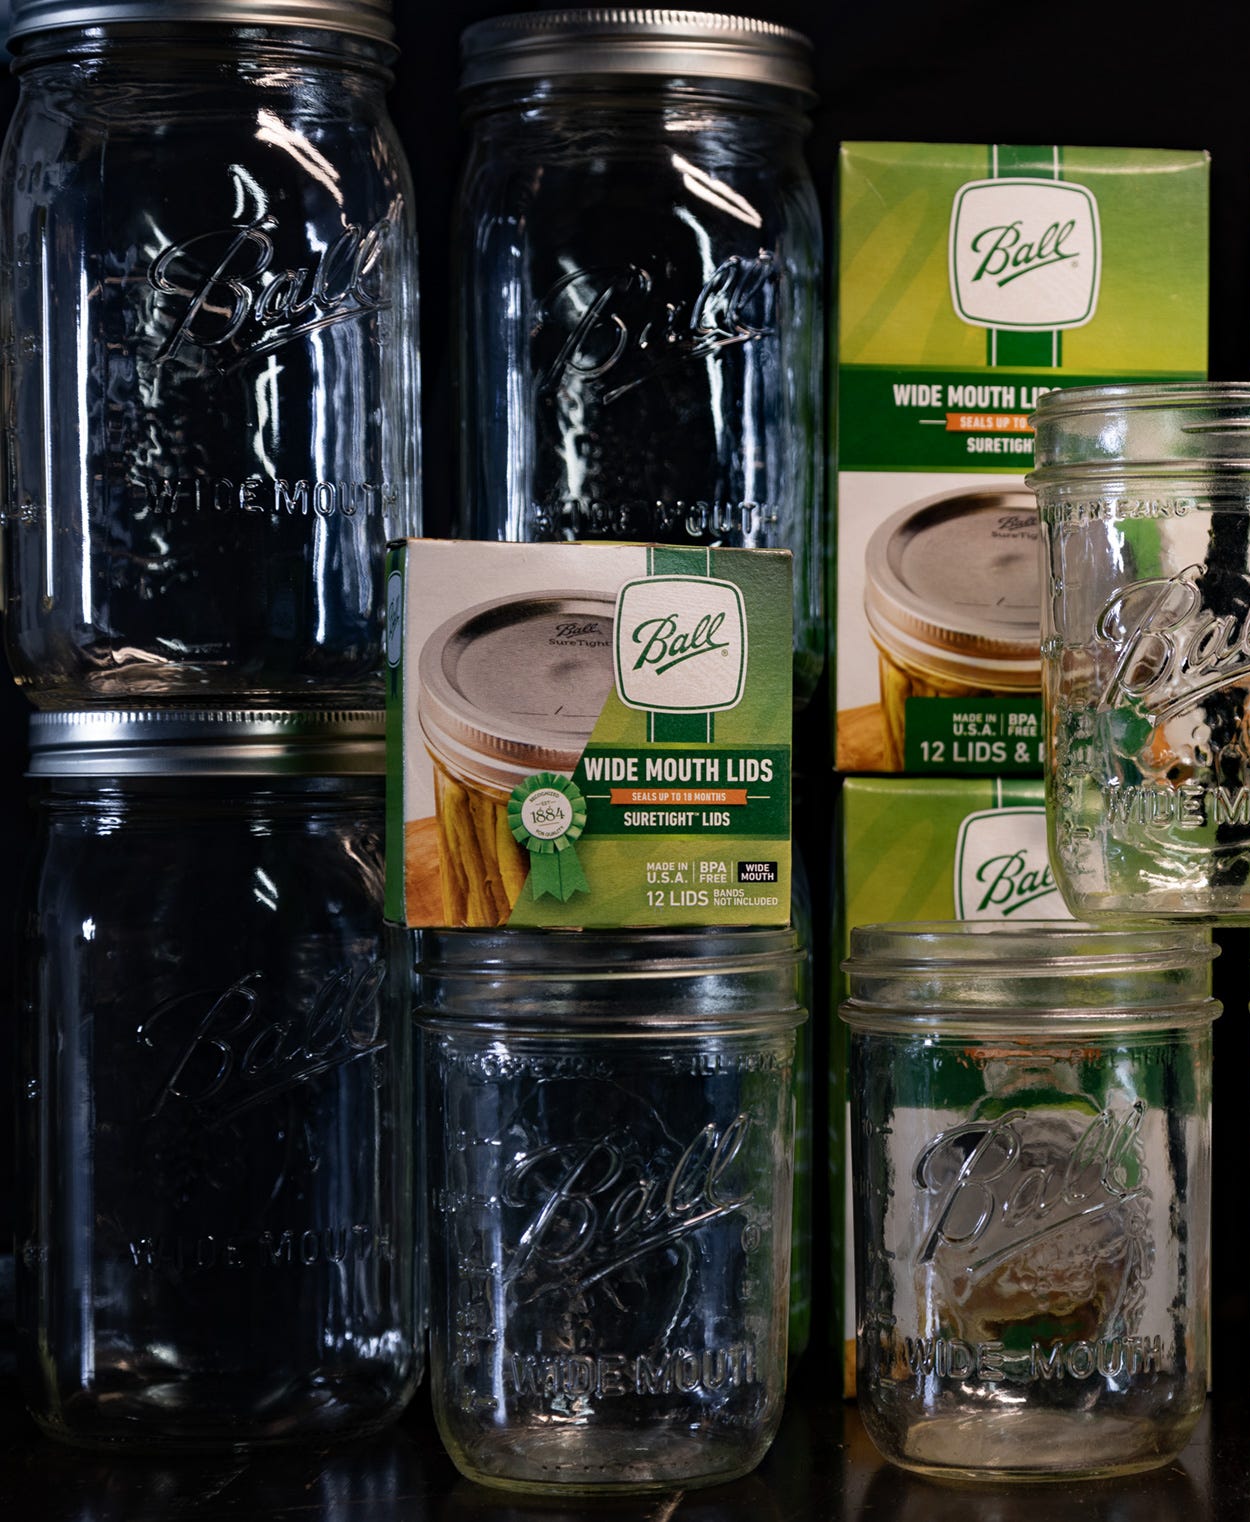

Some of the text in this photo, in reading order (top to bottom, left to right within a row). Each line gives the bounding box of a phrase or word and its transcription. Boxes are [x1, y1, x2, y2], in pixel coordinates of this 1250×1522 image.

[971, 219, 1080, 287] Ball
[146, 192, 404, 373] Ball
[893, 384, 1062, 409] WIDE MOUTH LI
[960, 415, 1026, 429] SEALS UP TO
[967, 437, 1035, 454] SURETIGH
[991, 531, 1037, 541] SureTig
[556, 622, 602, 639] Ball
[632, 612, 730, 676] Ball
[953, 713, 996, 722] MADE IN
[1008, 713, 1037, 726] BPA
[953, 724, 996, 736] U.S.A.
[1008, 726, 1037, 737] FREE
[920, 741, 945, 762] 12
[953, 741, 1007, 763] LIDS
[1014, 742, 1030, 762] &
[584, 757, 773, 782] WIDE MOUTH LIDS
[632, 792, 726, 802] SEALS UP TO 18 MONTHS
[1102, 784, 1207, 828] WIDE
[530, 807, 565, 824] 1884
[702, 812, 730, 826] LIDS
[646, 862, 688, 871] MADE IN
[700, 861, 727, 873] BPA
[745, 863, 770, 872] WIDE
[646, 872, 688, 884] U.S.A.
[700, 874, 727, 884] FREE
[741, 872, 774, 881] MOUTH
[976, 849, 1057, 916] Bal
[646, 888, 744, 906] 12 LIDS BANDS
[713, 897, 778, 906] NOT INCLUDED
[912, 1100, 1152, 1272] Ball
[500, 1112, 754, 1290] Ball
[905, 1334, 1164, 1382] WIDE MOUTH
[511, 1351, 628, 1398] WIDE
